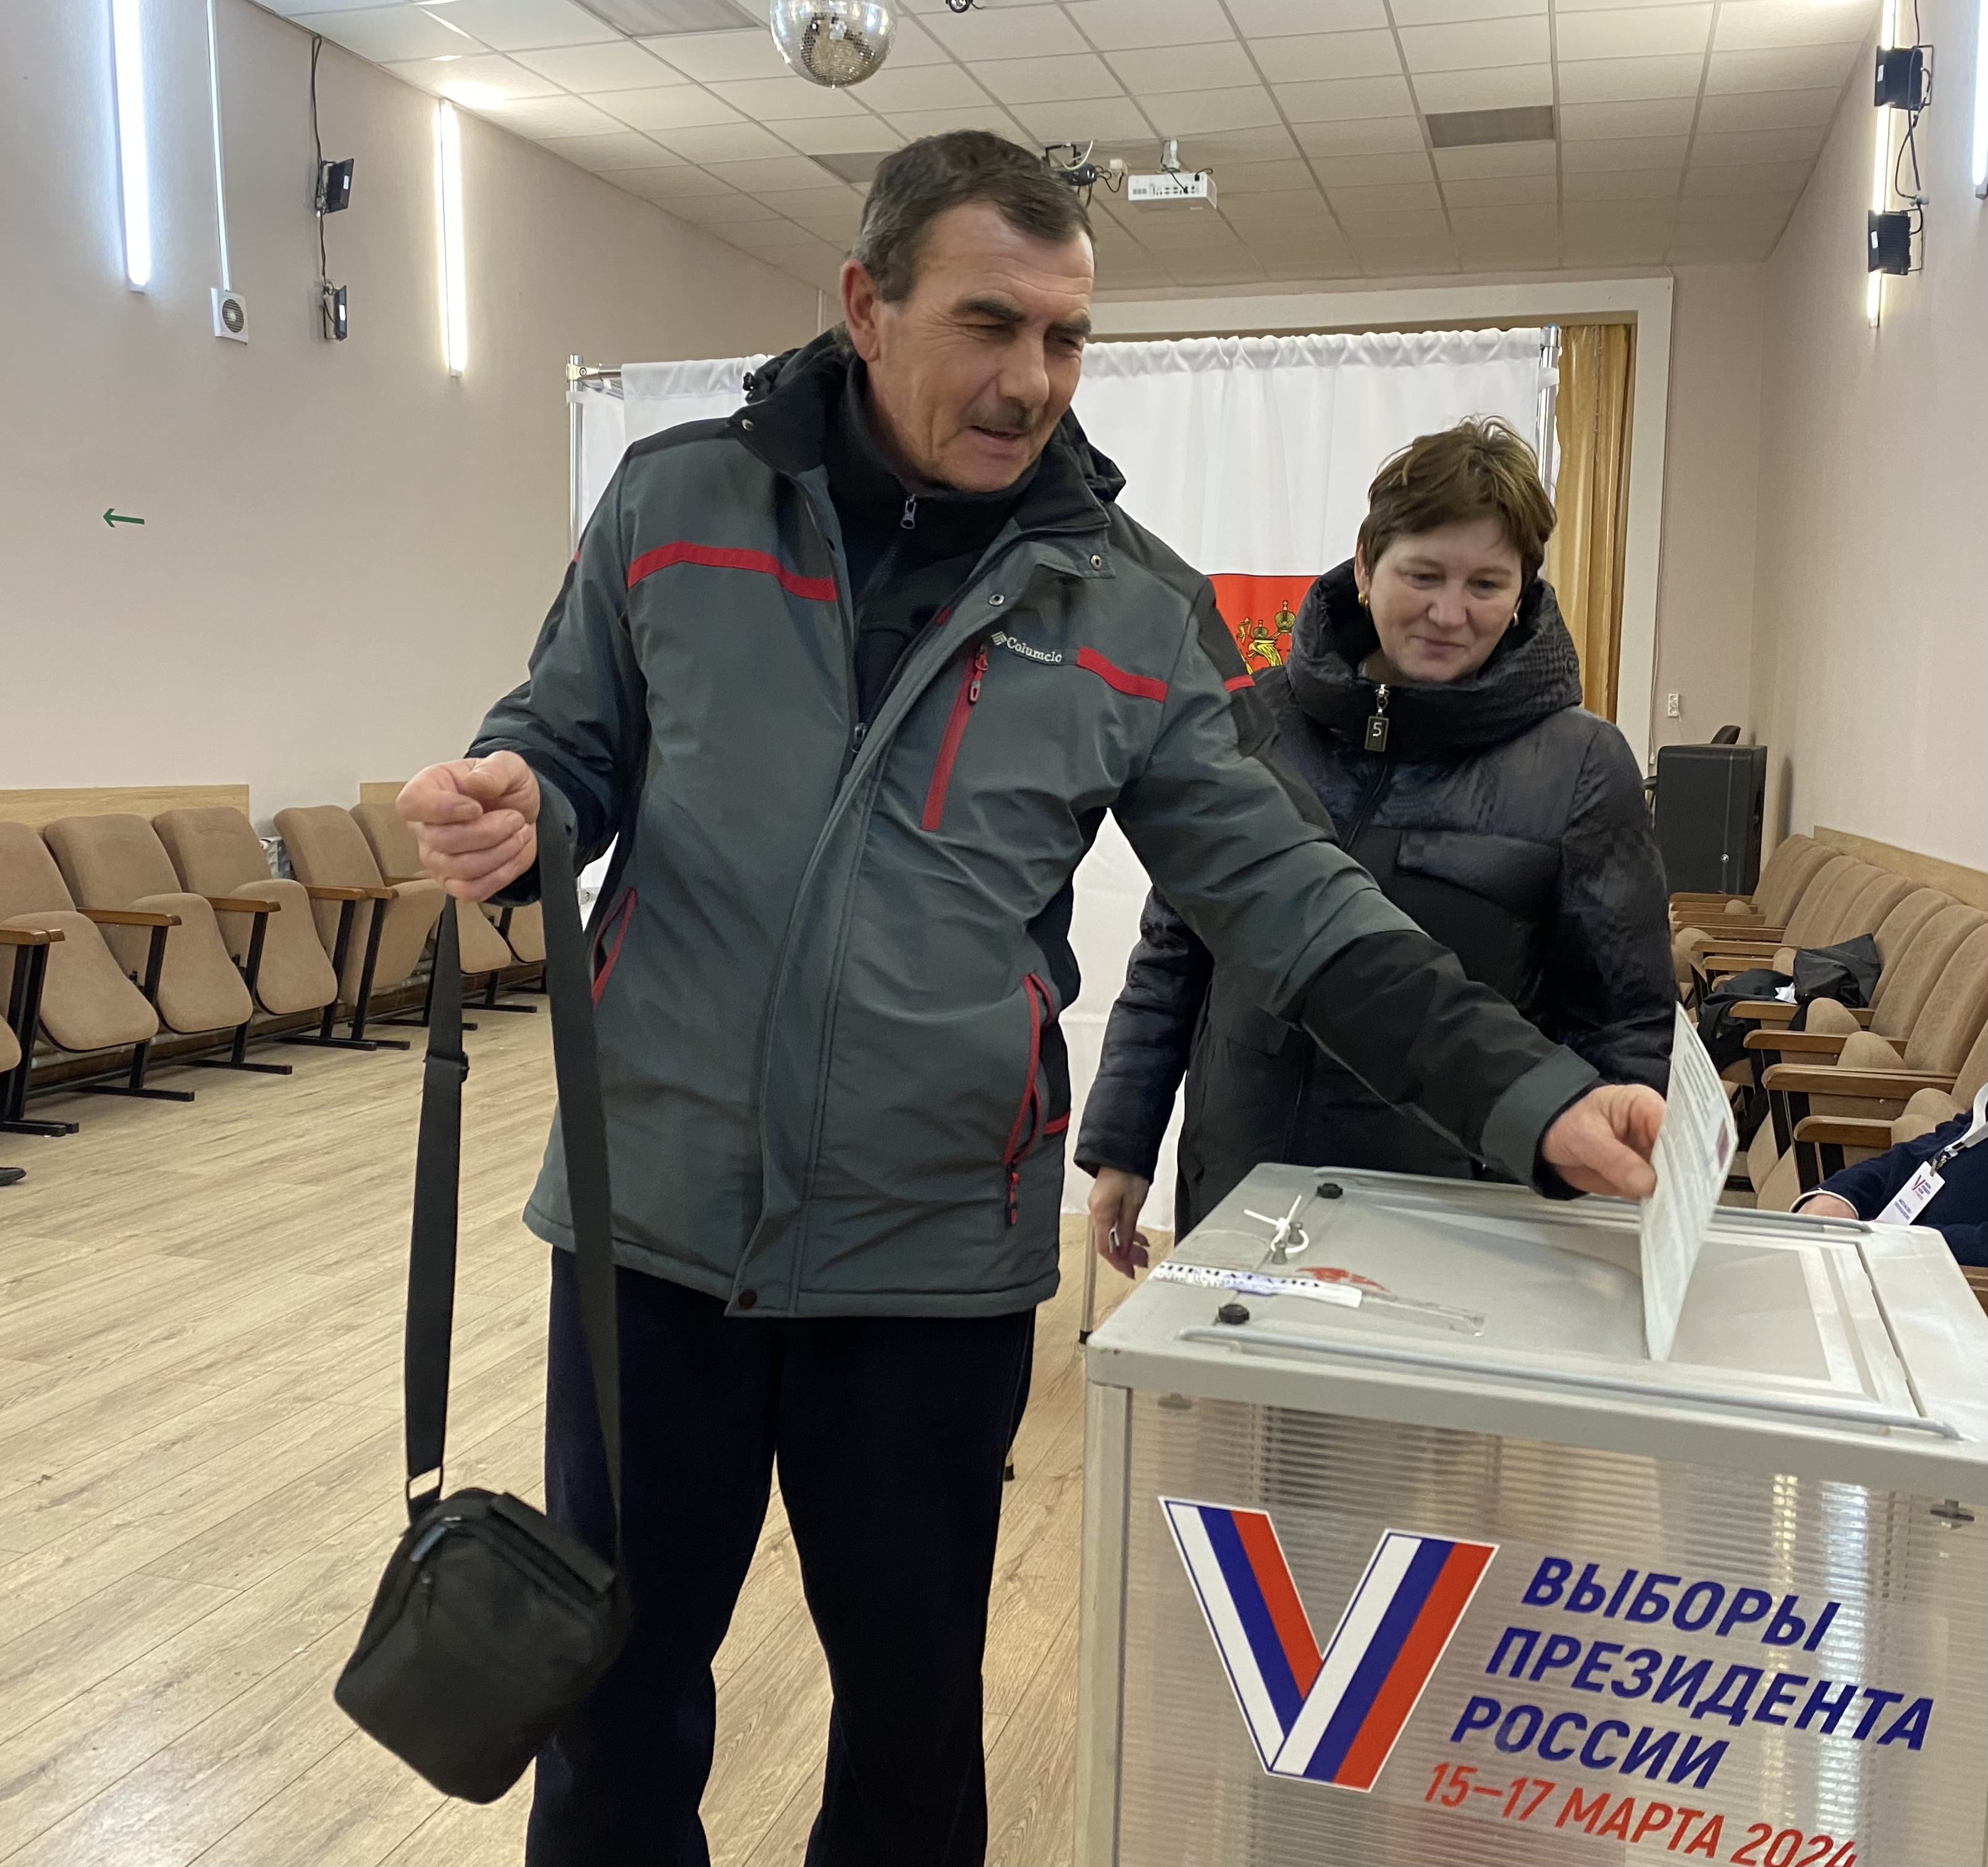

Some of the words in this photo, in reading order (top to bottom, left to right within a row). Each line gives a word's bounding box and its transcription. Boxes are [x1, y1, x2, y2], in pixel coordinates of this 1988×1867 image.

[1372, 722, 1383, 737] 5
[1521, 1556, 1842, 1652] ВЫБОРЫ
[1485, 1627, 1935, 1751] ПРЕЗИДЕНТА
[1450, 1695, 1730, 1789] РОССИИ
[1555, 1787, 1725, 1859] МАРТА
